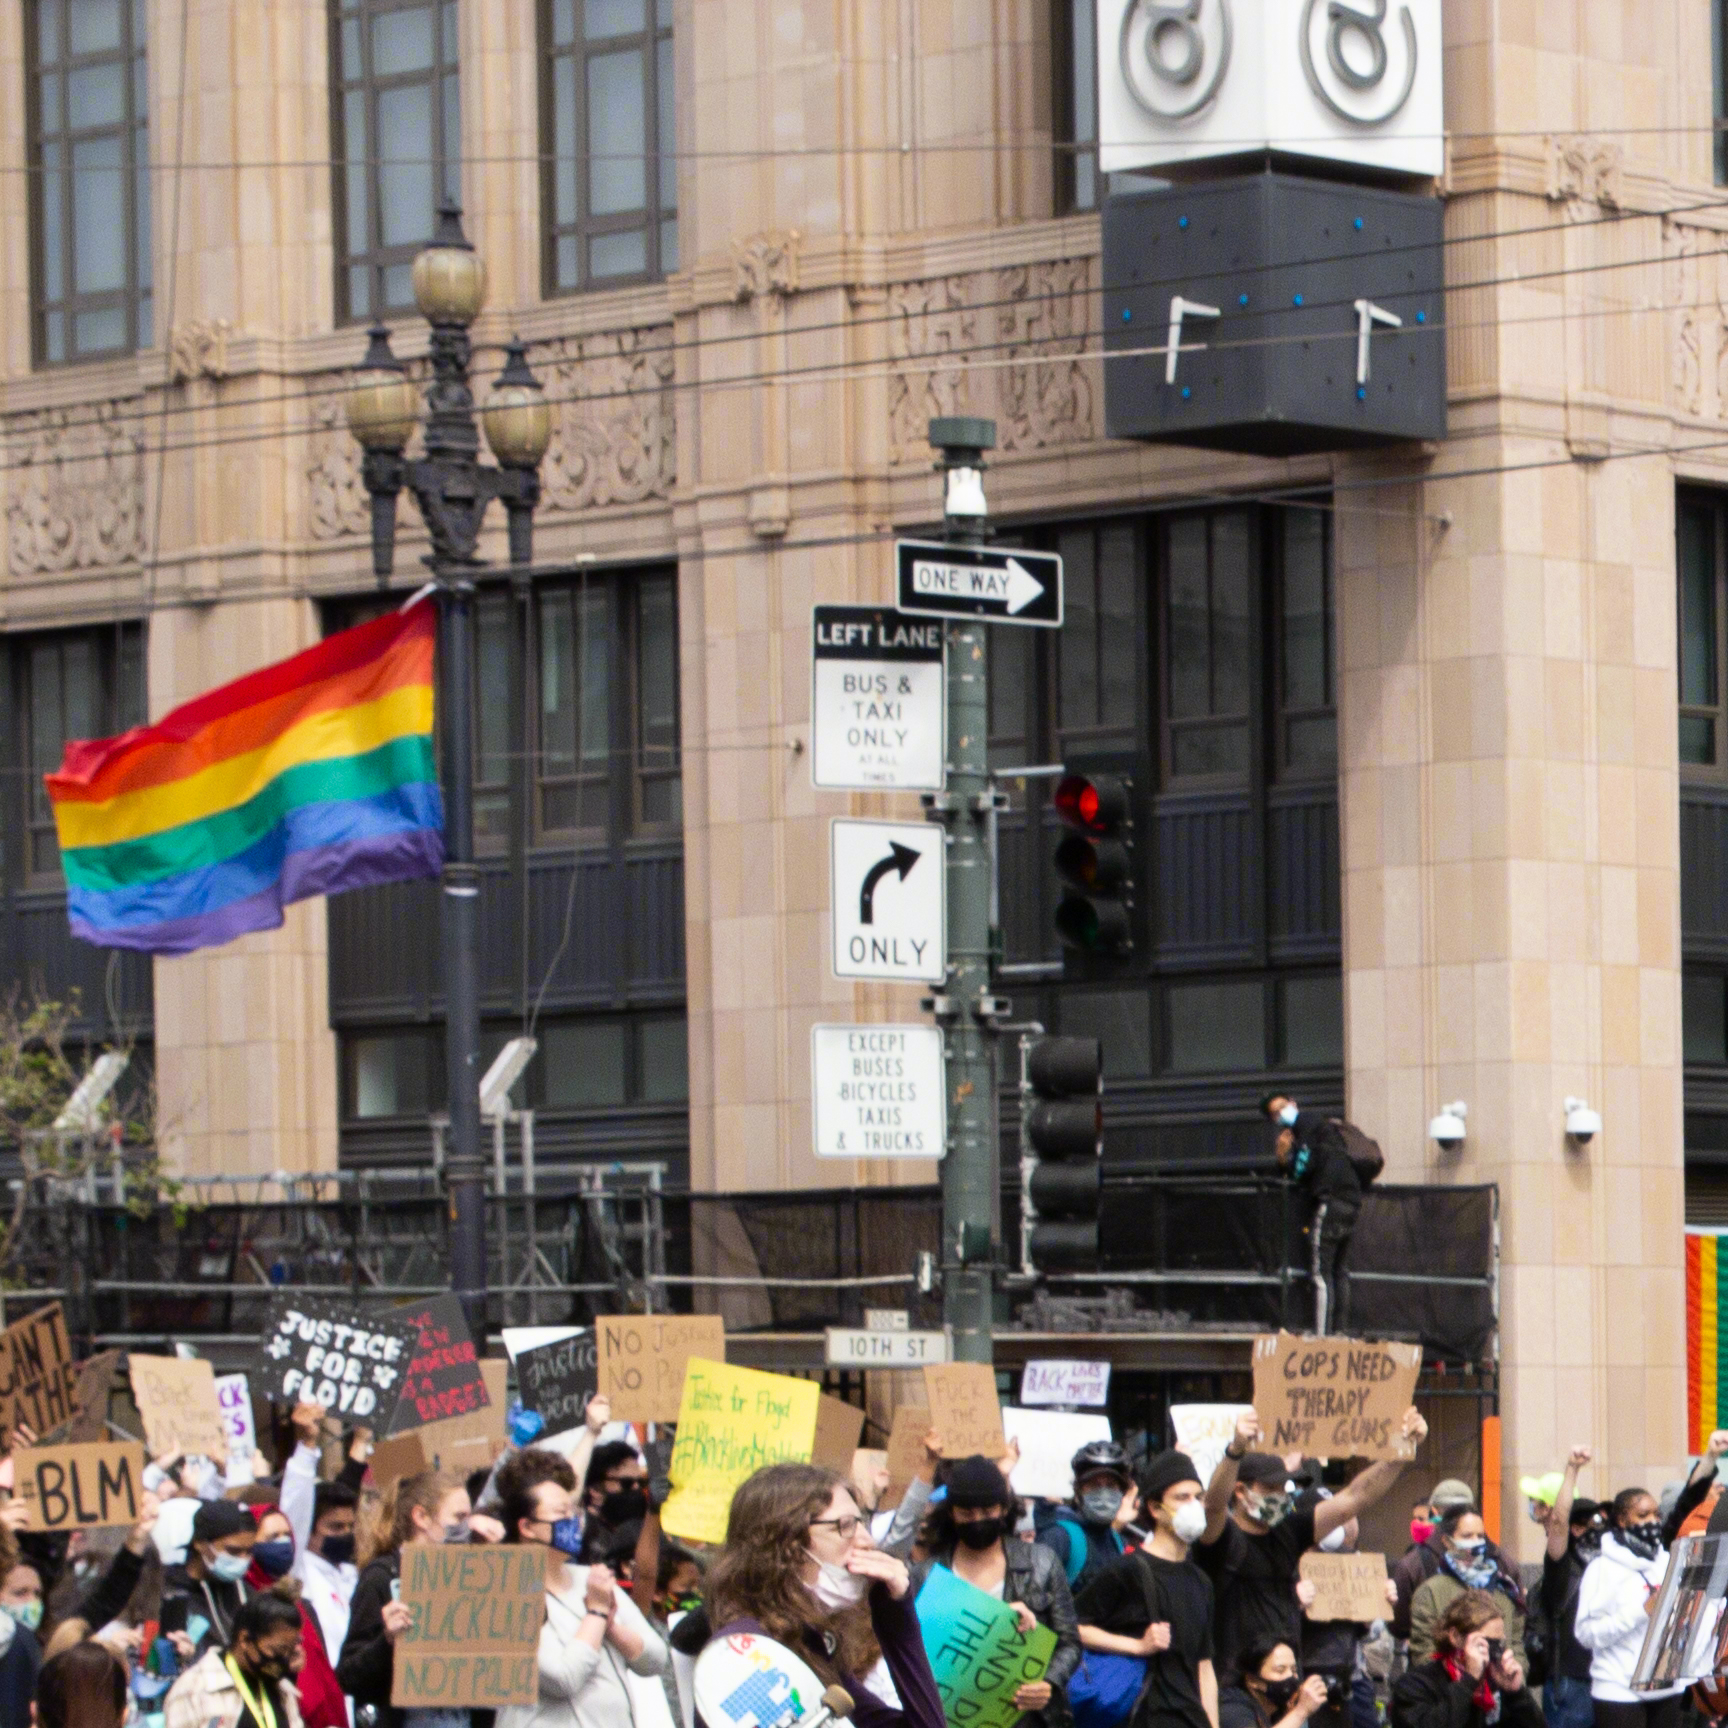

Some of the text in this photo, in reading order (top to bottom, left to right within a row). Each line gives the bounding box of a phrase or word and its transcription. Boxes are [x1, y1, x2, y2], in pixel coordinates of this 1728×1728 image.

[919, 567, 1011, 596] ONE WAY
[817, 623, 939, 648] LEFT LANE
[843, 674, 912, 694] BUS &
[853, 701, 901, 720] TAXI
[848, 729, 908, 747] ONLY
[859, 754, 897, 765] AT ALL
[862, 772, 896, 782] TIMES
[850, 935, 927, 966] ONLY
[849, 1033, 906, 1052] EXCEPT
[853, 1058, 904, 1077] BUSES
[840, 1083, 917, 1101] BICYCLES
[858, 1107, 902, 1125] TAXIS
[836, 1131, 924, 1150] & TRUCKS
[280, 1309, 403, 1361] JUSTICE
[606, 1325, 642, 1357] NO
[849, 1337, 926, 1357] 10TH ST
[306, 1345, 362, 1383] FOR
[527, 1338, 597, 1389] justic
[608, 1365, 642, 1392] NO
[1283, 1350, 1396, 1382] COPS NEED
[283, 1368, 377, 1416] FLOYD
[1286, 1388, 1370, 1418] THERAPY
[1274, 1417, 1392, 1448] NOT GUNS
[22, 1456, 136, 1525] #BLM
[411, 1551, 513, 1593] INVEST
[403, 1594, 486, 1643] BLACK
[936, 1609, 998, 1675] THE
[974, 1619, 1027, 1691] AND
[404, 1656, 467, 1698] NOT
